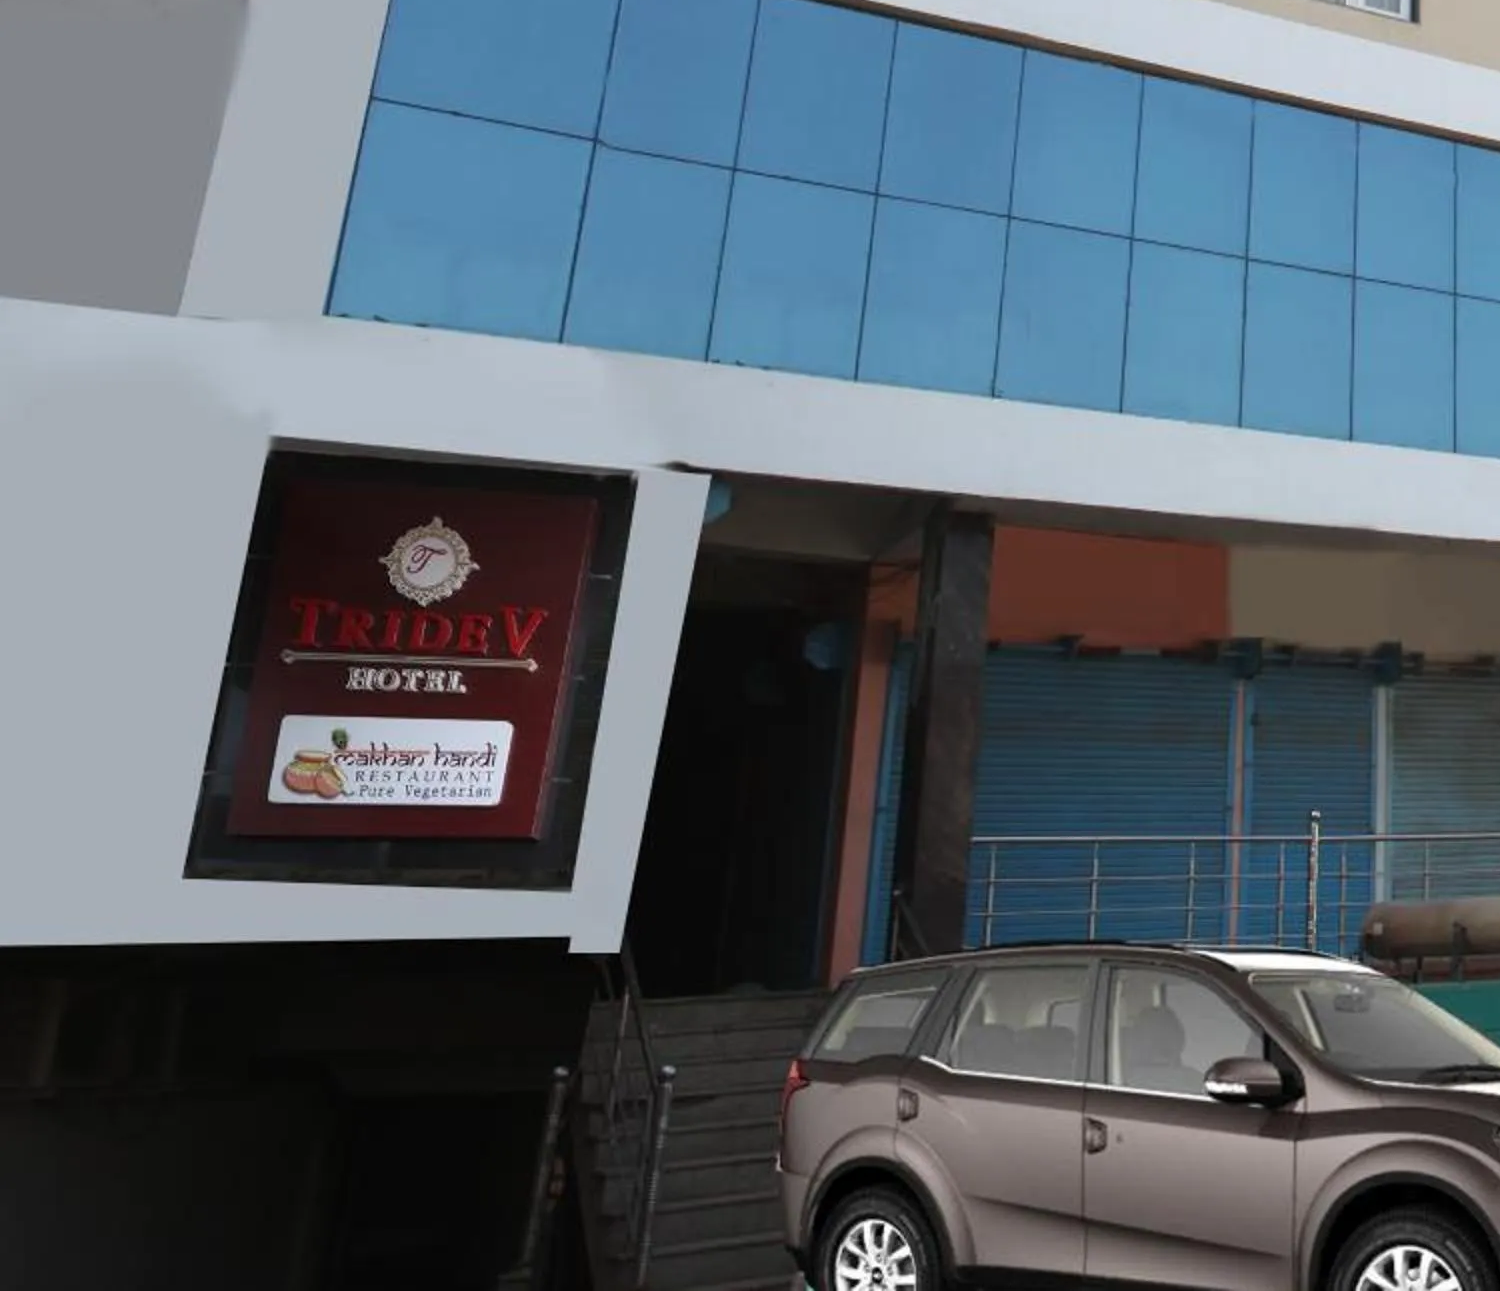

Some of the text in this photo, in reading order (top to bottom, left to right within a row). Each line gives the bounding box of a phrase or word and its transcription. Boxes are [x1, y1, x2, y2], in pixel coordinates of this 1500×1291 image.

[291, 598, 548, 657] TRIDEV
[346, 666, 467, 693] HOTEL
[334, 741, 498, 767] makhan handi
[355, 770, 494, 783] RESTAURANT
[358, 784, 492, 800] Pure Vegetarian
